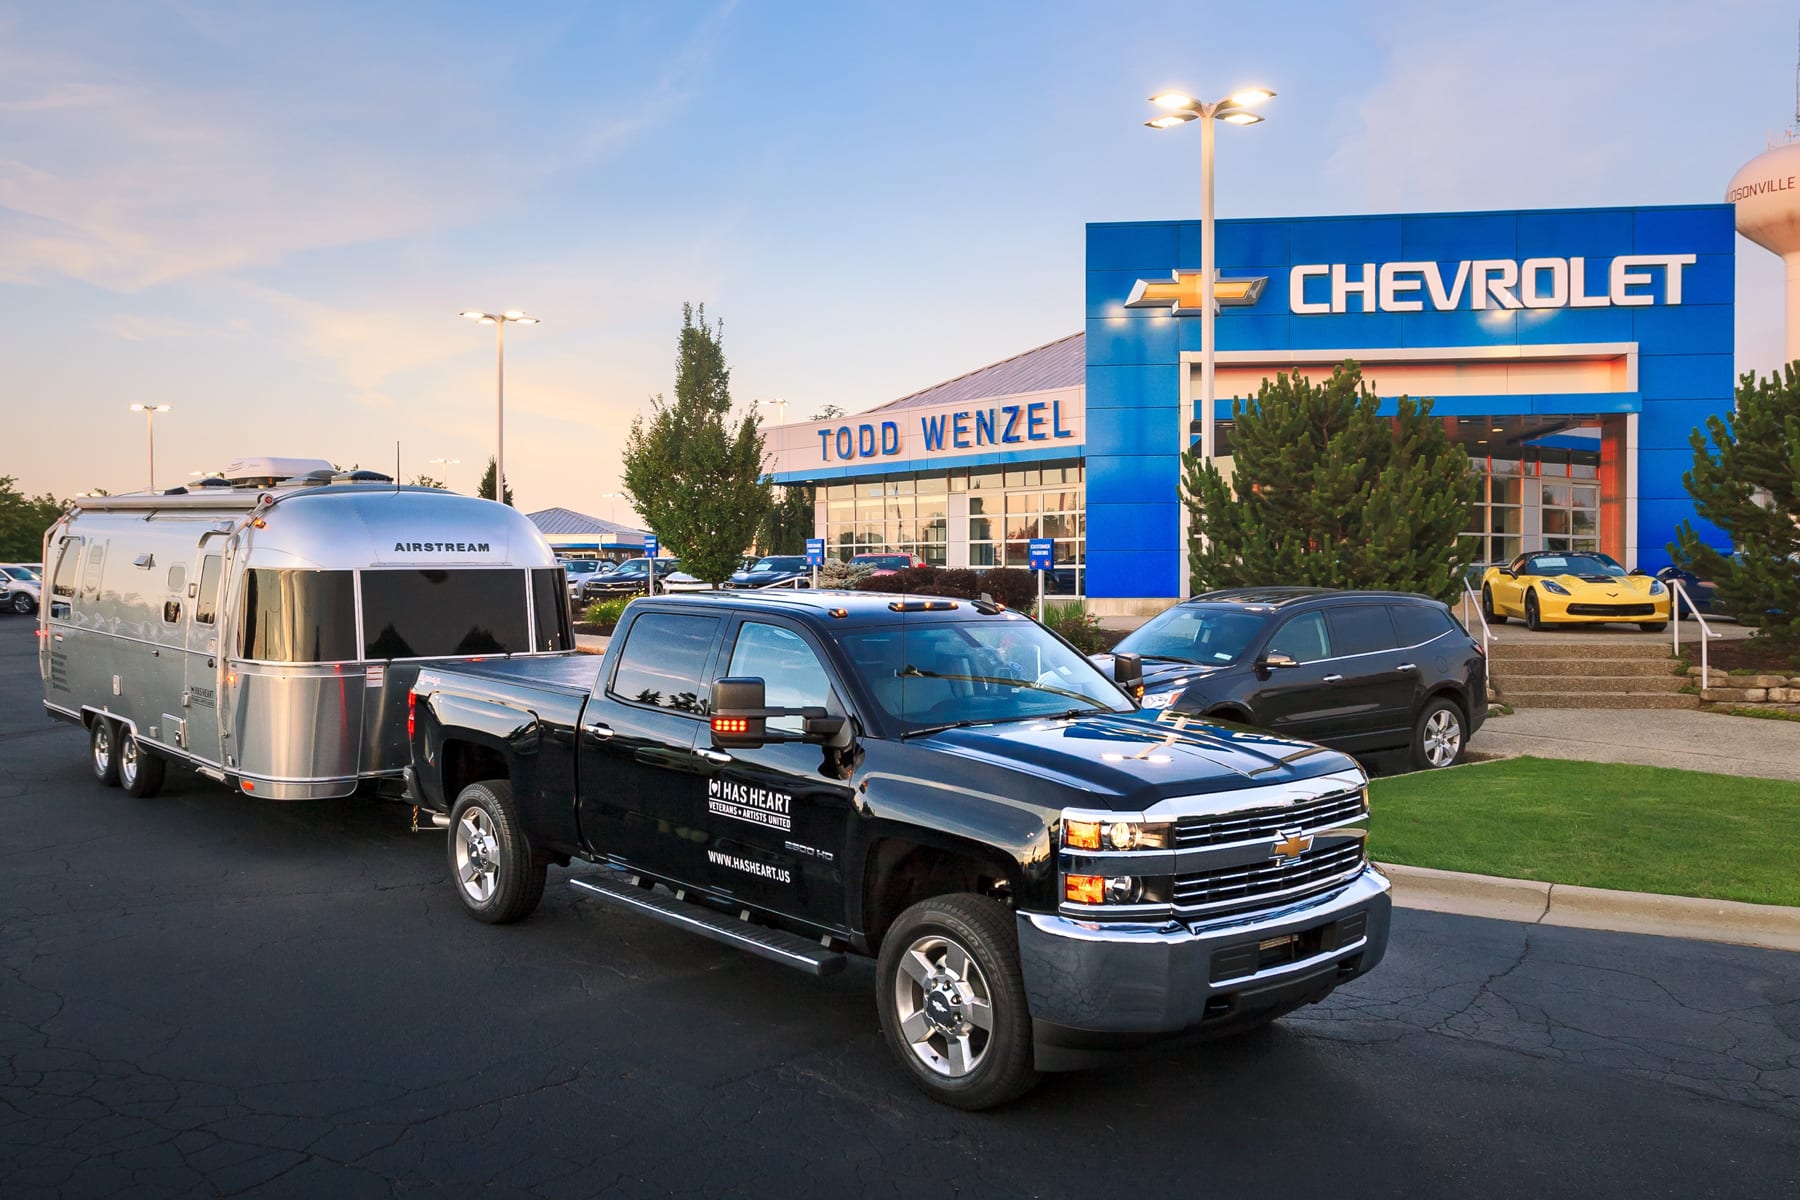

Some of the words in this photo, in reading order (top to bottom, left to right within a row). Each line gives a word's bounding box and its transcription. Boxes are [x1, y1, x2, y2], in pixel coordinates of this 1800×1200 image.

[1729, 176, 1796, 202] DSONVILLE
[1290, 254, 1697, 313] CHEVROLET
[818, 421, 900, 462] TODD
[921, 400, 1072, 451] WENZEL
[394, 542, 490, 552] AIRSTREAM
[723, 781, 747, 804] HAS
[750, 787, 791, 813] HEART
[708, 801, 738, 816] VETERANS
[743, 808, 767, 823] ARTISTS
[768, 815, 791, 829] UNITED
[707, 850, 791, 883] WWW.HASHEART.US
